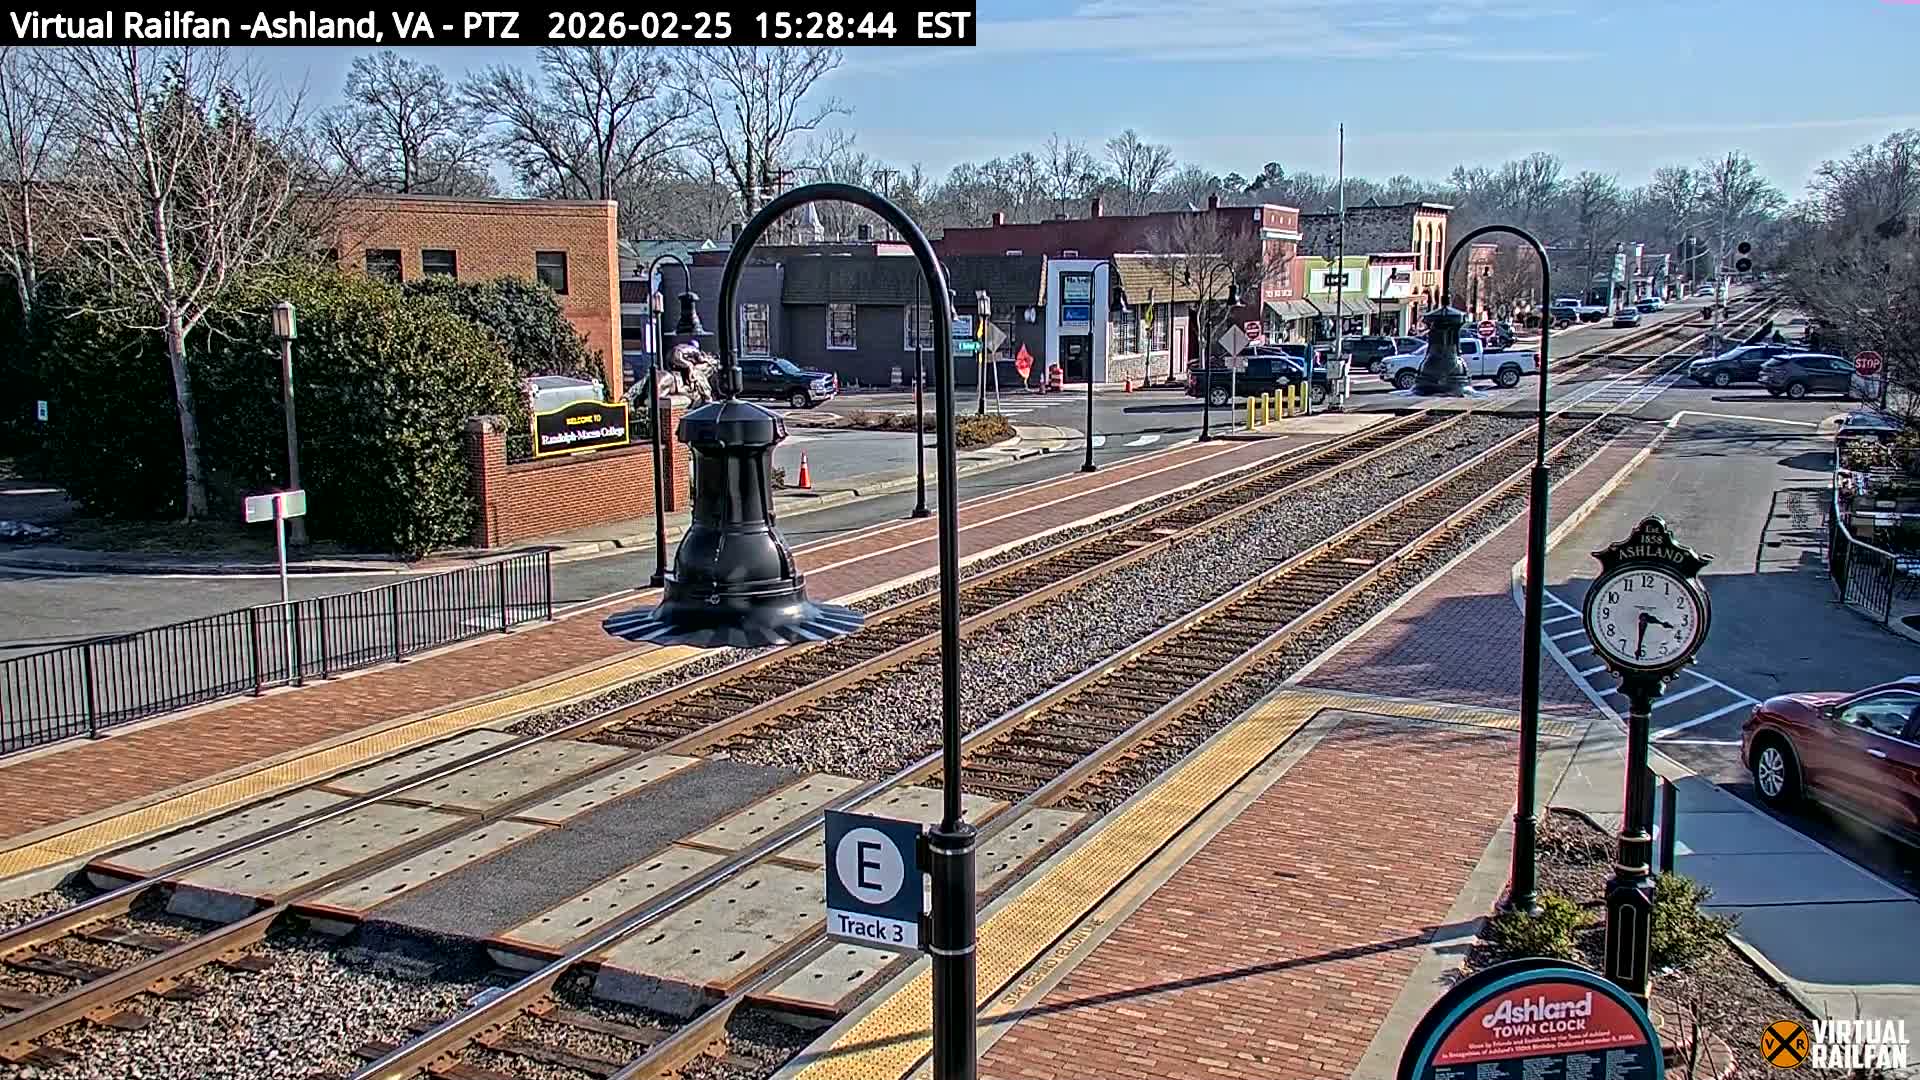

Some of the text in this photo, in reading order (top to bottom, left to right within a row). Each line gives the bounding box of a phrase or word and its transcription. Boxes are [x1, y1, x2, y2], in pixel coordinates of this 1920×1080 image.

[1856, 358, 1880, 368] STOP
[566, 414, 601, 425] WELCOME TO
[601, 426, 624, 437] College
[1619, 545, 1684, 563] ASHLAND
[1624, 579, 1632, 592] 11
[1641, 576, 1655, 588] 12
[1664, 582, 1669, 595] 1
[1608, 592, 1620, 604] 10
[1676, 596, 1684, 609] 2
[1602, 608, 1610, 619] 9
[1681, 614, 1688, 627] 3
[1606, 624, 1616, 636] 8
[1674, 630, 1682, 643] 4
[1620, 639, 1626, 654] 7
[1639, 645, 1647, 657] 6
[1659, 642, 1668, 654] 5
[858, 841, 882, 891] E
[838, 914, 904, 942] Track 3
[1482, 991, 1592, 1028] Ashland
[1493, 1019, 1586, 1039] TOWN CLOCK
